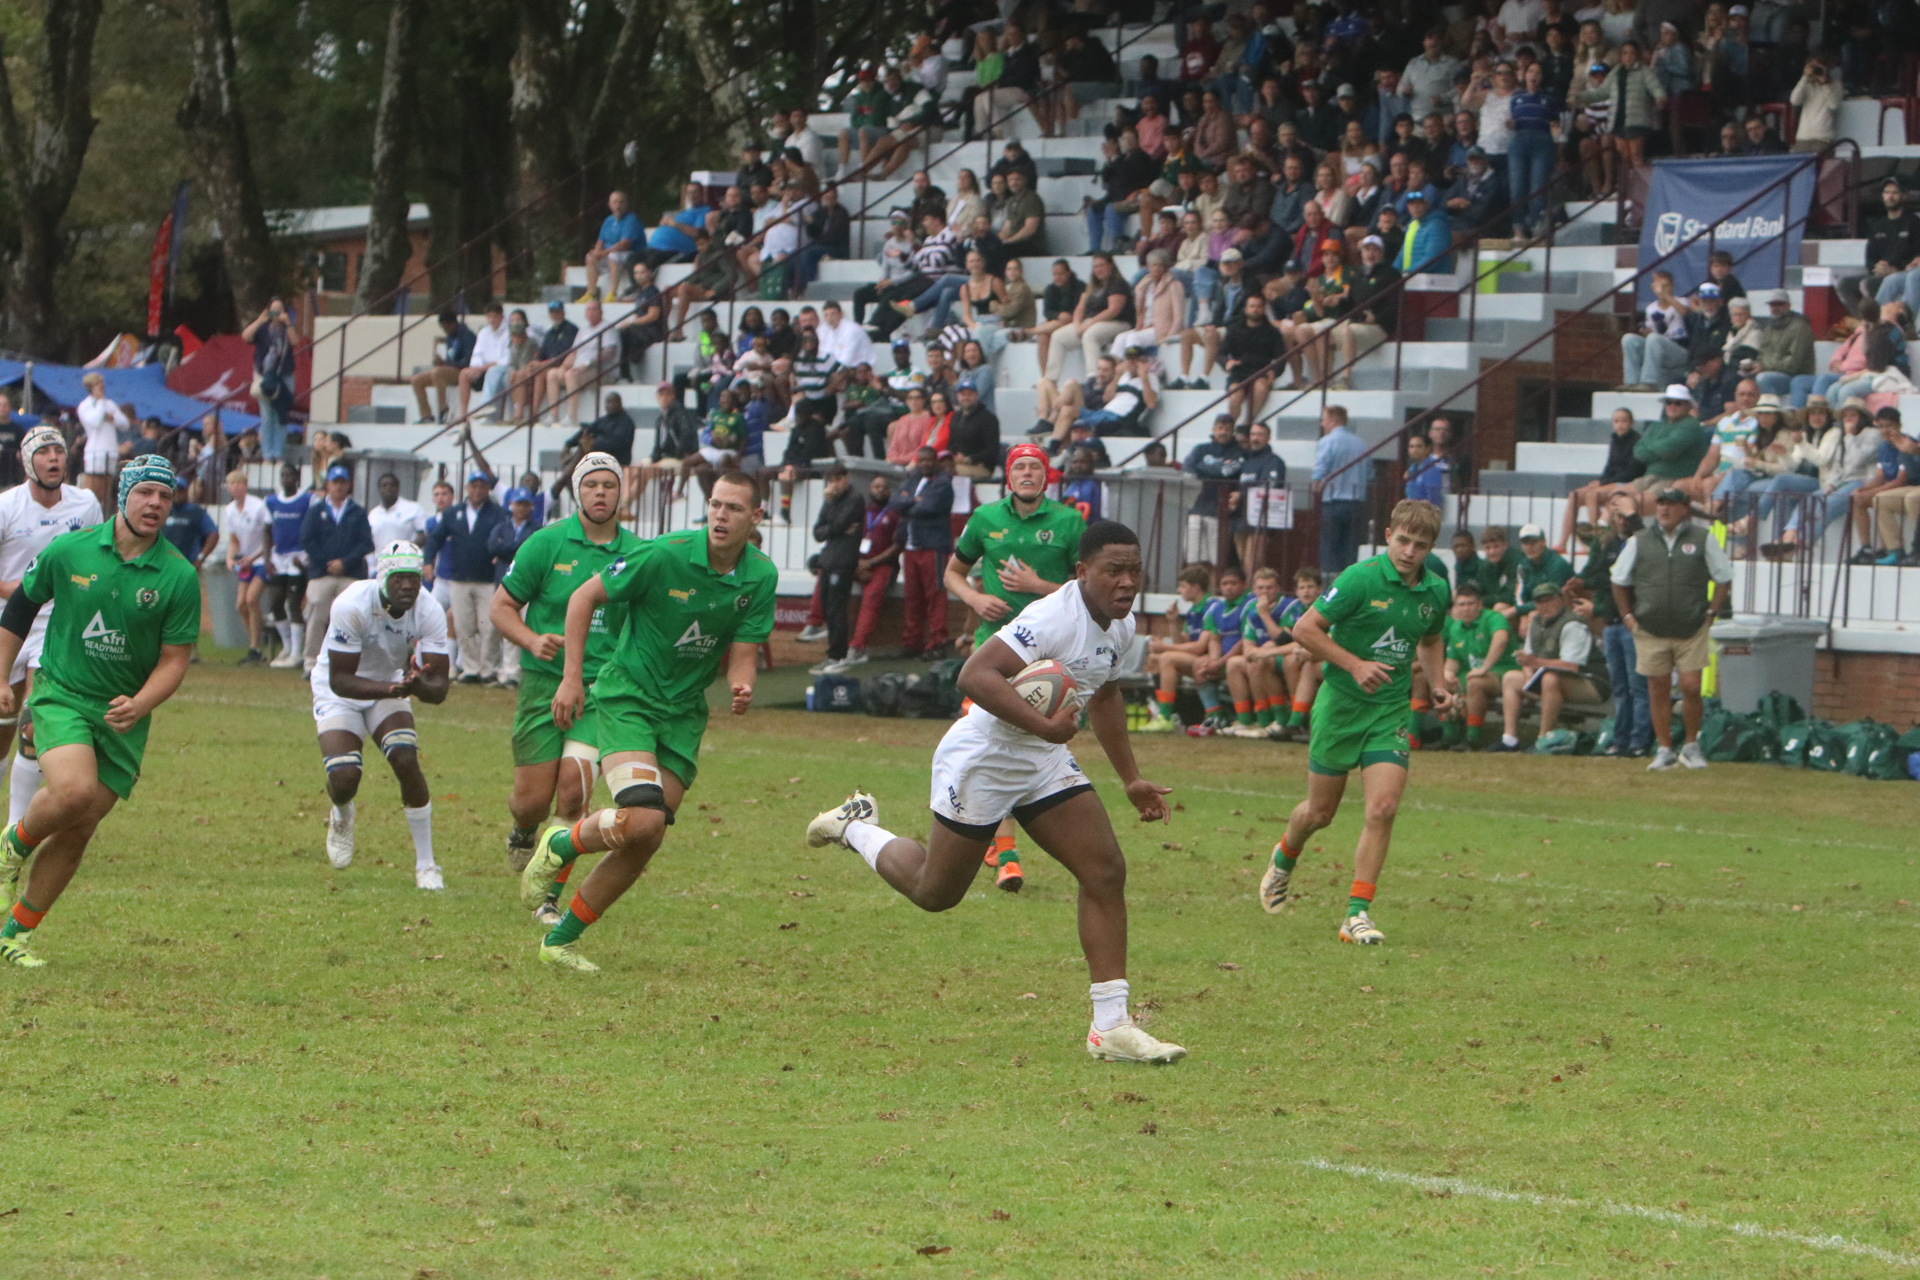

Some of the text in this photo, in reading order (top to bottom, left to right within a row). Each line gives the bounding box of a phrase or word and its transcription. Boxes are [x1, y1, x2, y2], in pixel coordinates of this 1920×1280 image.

[1681, 216, 1751, 240] Stdard
[84, 639, 125, 653] READYMIX
[948, 785, 965, 814] BLK
